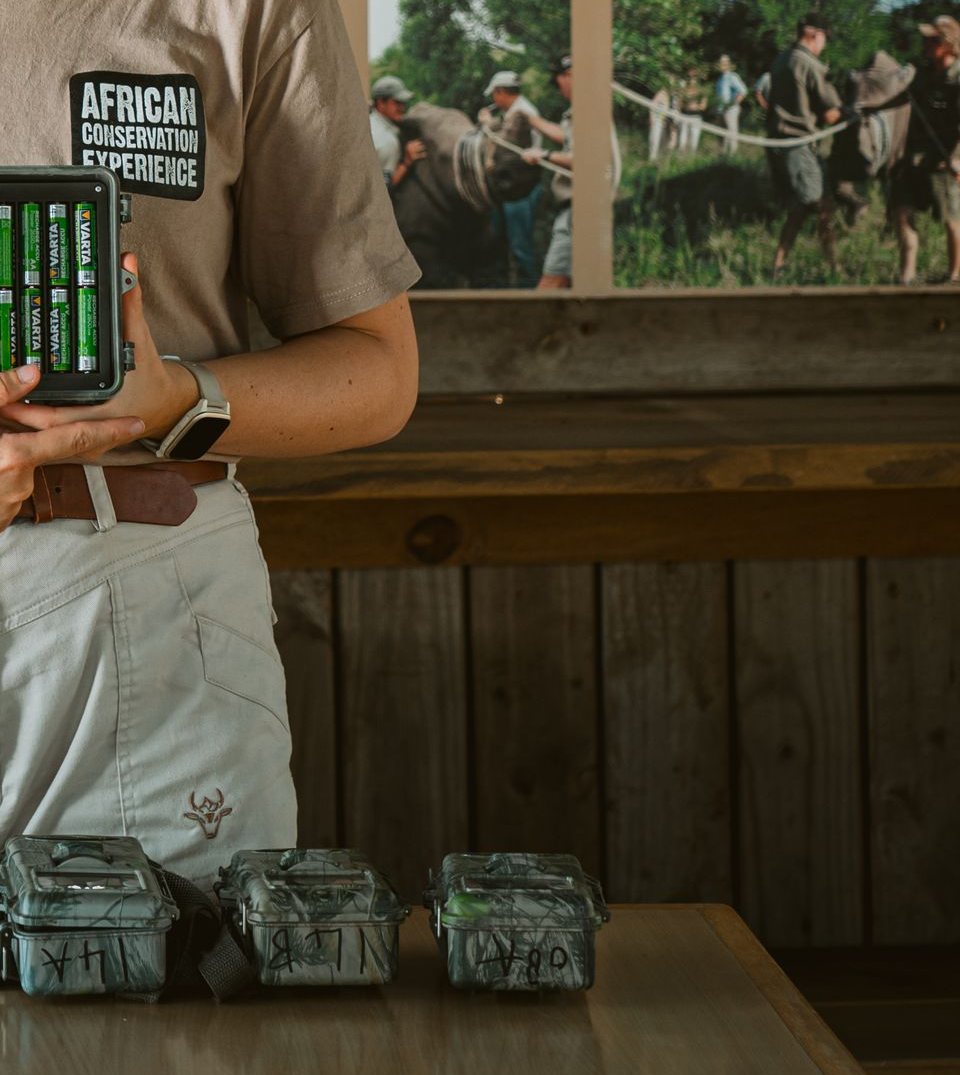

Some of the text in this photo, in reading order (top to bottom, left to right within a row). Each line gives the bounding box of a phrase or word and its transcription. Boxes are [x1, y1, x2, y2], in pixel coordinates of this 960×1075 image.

[81, 82, 197, 126] AFRICAN
[81, 122, 199, 154] CONSERVATION
[30, 258, 37, 270] AA
[49, 223, 59, 266] VARTA
[80, 221, 91, 266] VARTA
[31, 308, 41, 351] VARTA
[49, 308, 59, 352] VARTA
[41, 937, 129, 984] 14A
